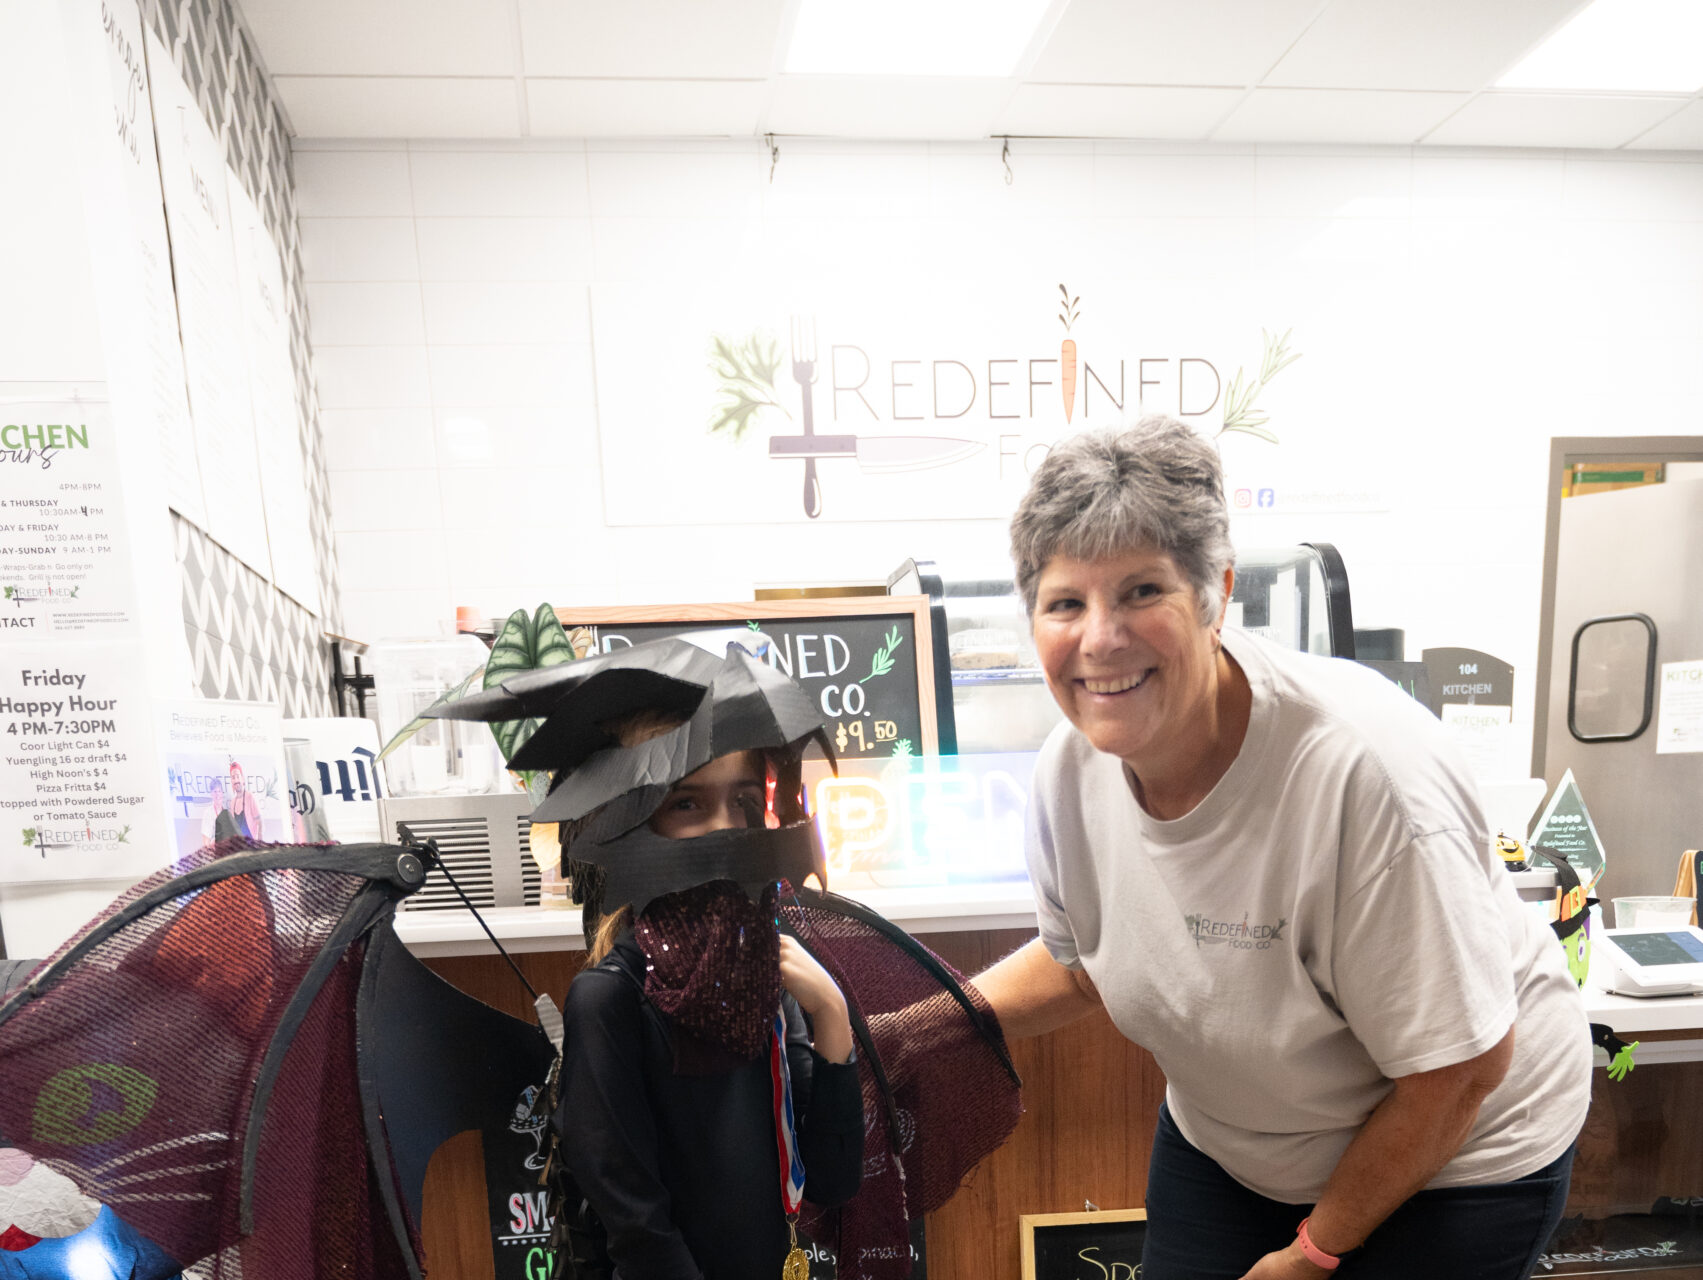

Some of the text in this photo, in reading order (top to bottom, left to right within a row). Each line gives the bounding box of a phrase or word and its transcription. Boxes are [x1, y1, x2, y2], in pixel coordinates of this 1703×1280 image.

[1000, 434, 1050, 481] FO
[0, 617, 36, 628] TACT
[768, 633, 850, 678] NED
[1459, 664, 1478, 674] 104
[21, 669, 86, 690] Friday
[1443, 684, 1492, 695] KITCHEN
[0, 695, 117, 718] Happy Hour
[820, 683, 871, 717] CO.
[7, 720, 116, 735] 4 PM-7:30PM
[20, 740, 110, 752] Coor Light Can $4
[6, 756, 58, 767] Yuengling
[60, 756, 72, 764] 16
[88, 754, 112, 763] draft
[115, 753, 127, 762] $4
[30, 768, 109, 780] High Noon's $ 4
[37, 782, 107, 793] Pizza Fritta $4
[40, 797, 62, 806] with
[65, 795, 115, 805] Powdered
[117, 795, 145, 806] Sugar
[34, 810, 118, 821] or Tomato Sauce
[816, 766, 1029, 876] PEN
[1201, 919, 1272, 939] REDEFINED
[509, 1191, 556, 1234] SM
